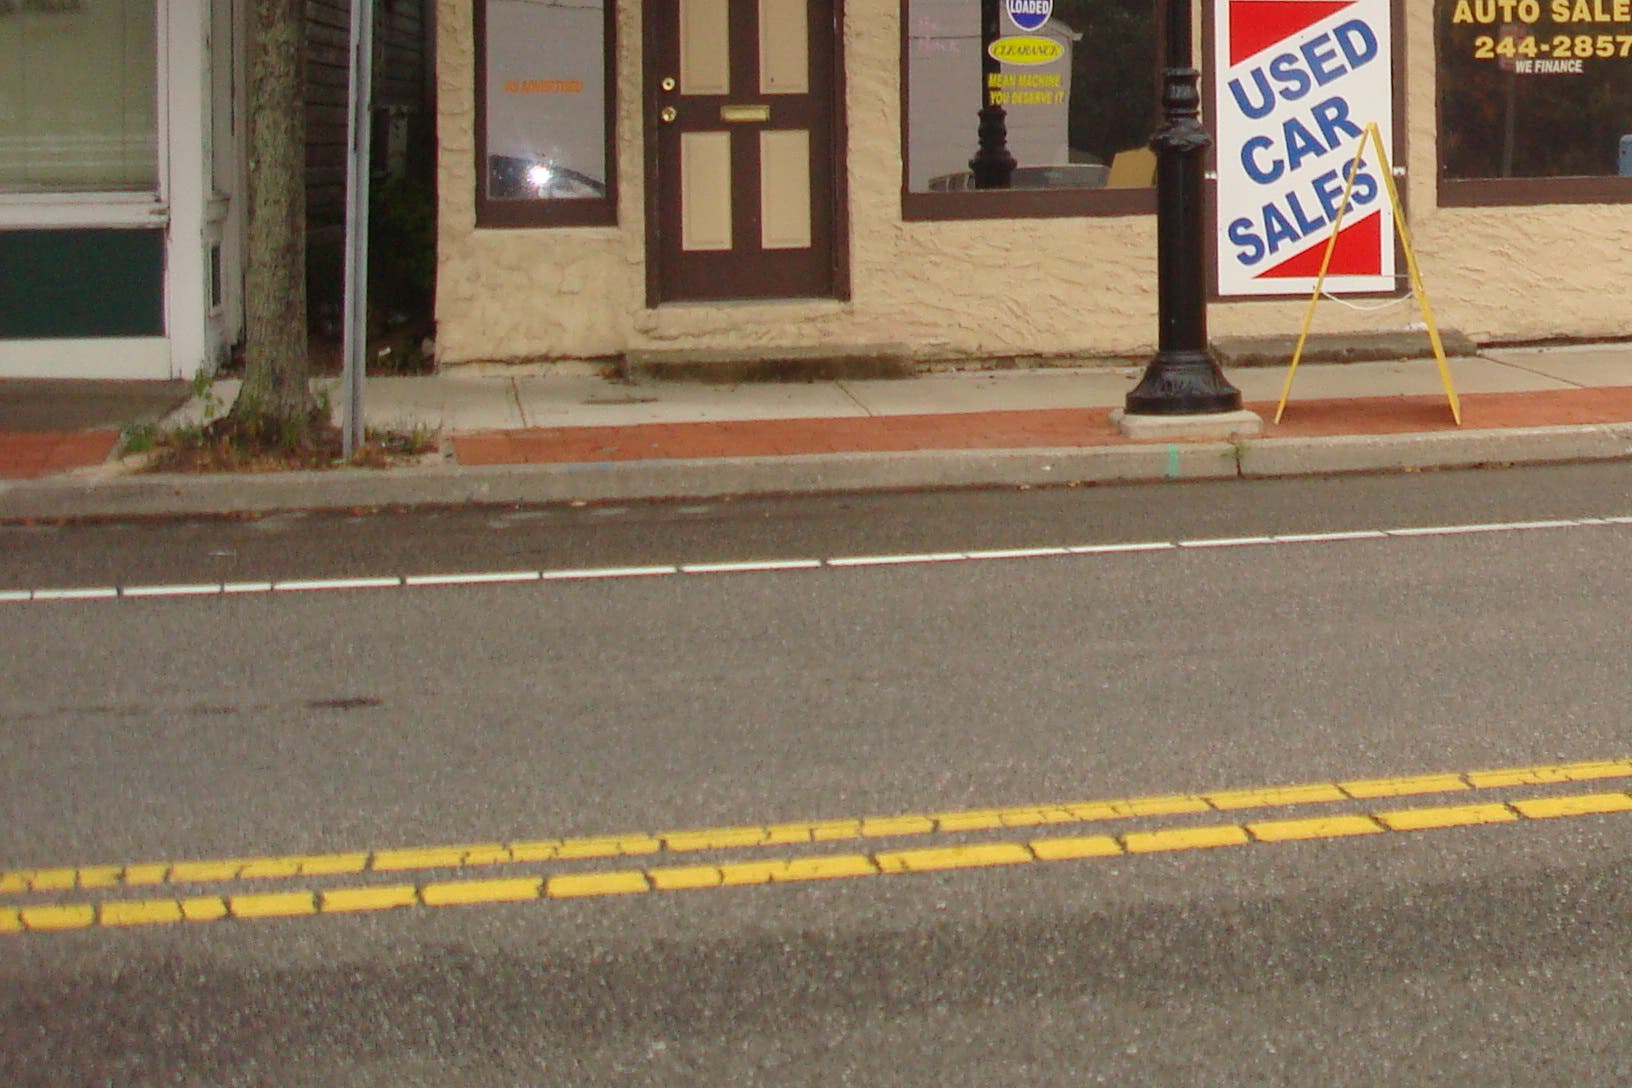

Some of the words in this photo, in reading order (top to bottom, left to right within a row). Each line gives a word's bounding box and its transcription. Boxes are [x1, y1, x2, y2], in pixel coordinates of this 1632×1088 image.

[1010, 0, 1049, 15] LOADED
[992, 44, 1060, 58] CLEARANCE
[1227, 18, 1378, 120] USED
[1515, 60, 1533, 73] WE
[1534, 59, 1584, 73] FINANCE
[990, 91, 1010, 105] YOU
[1055, 90, 1065, 105] IT
[1240, 96, 1364, 185] CAR
[1227, 157, 1378, 266] SALES
